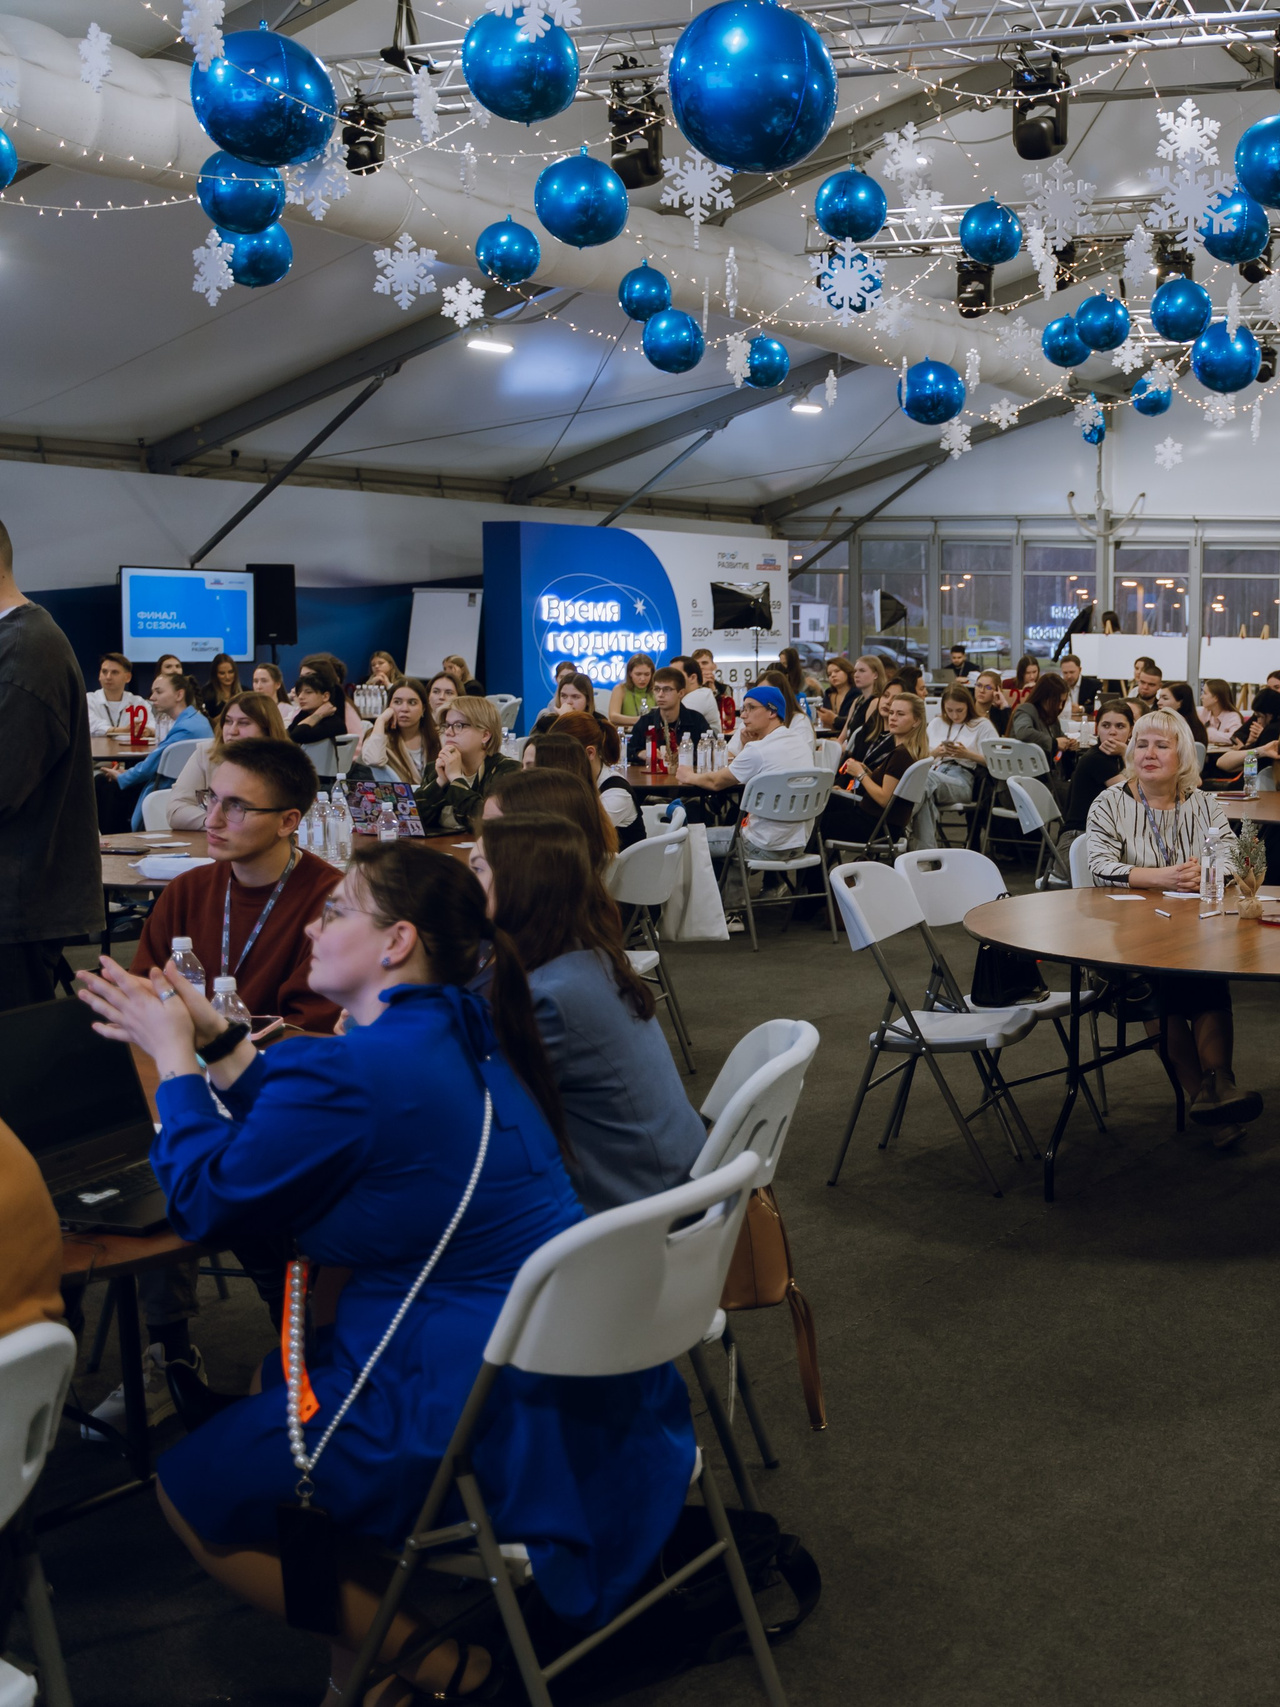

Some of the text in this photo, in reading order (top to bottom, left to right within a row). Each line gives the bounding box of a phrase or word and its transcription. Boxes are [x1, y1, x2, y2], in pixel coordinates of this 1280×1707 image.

[137, 611, 177, 620] ФИНАЛ
[541, 595, 620, 626] Время
[146, 622, 187, 630] СЕЗОНА
[546, 631, 667, 656] гордиться
[126, 705, 149, 745] 12
